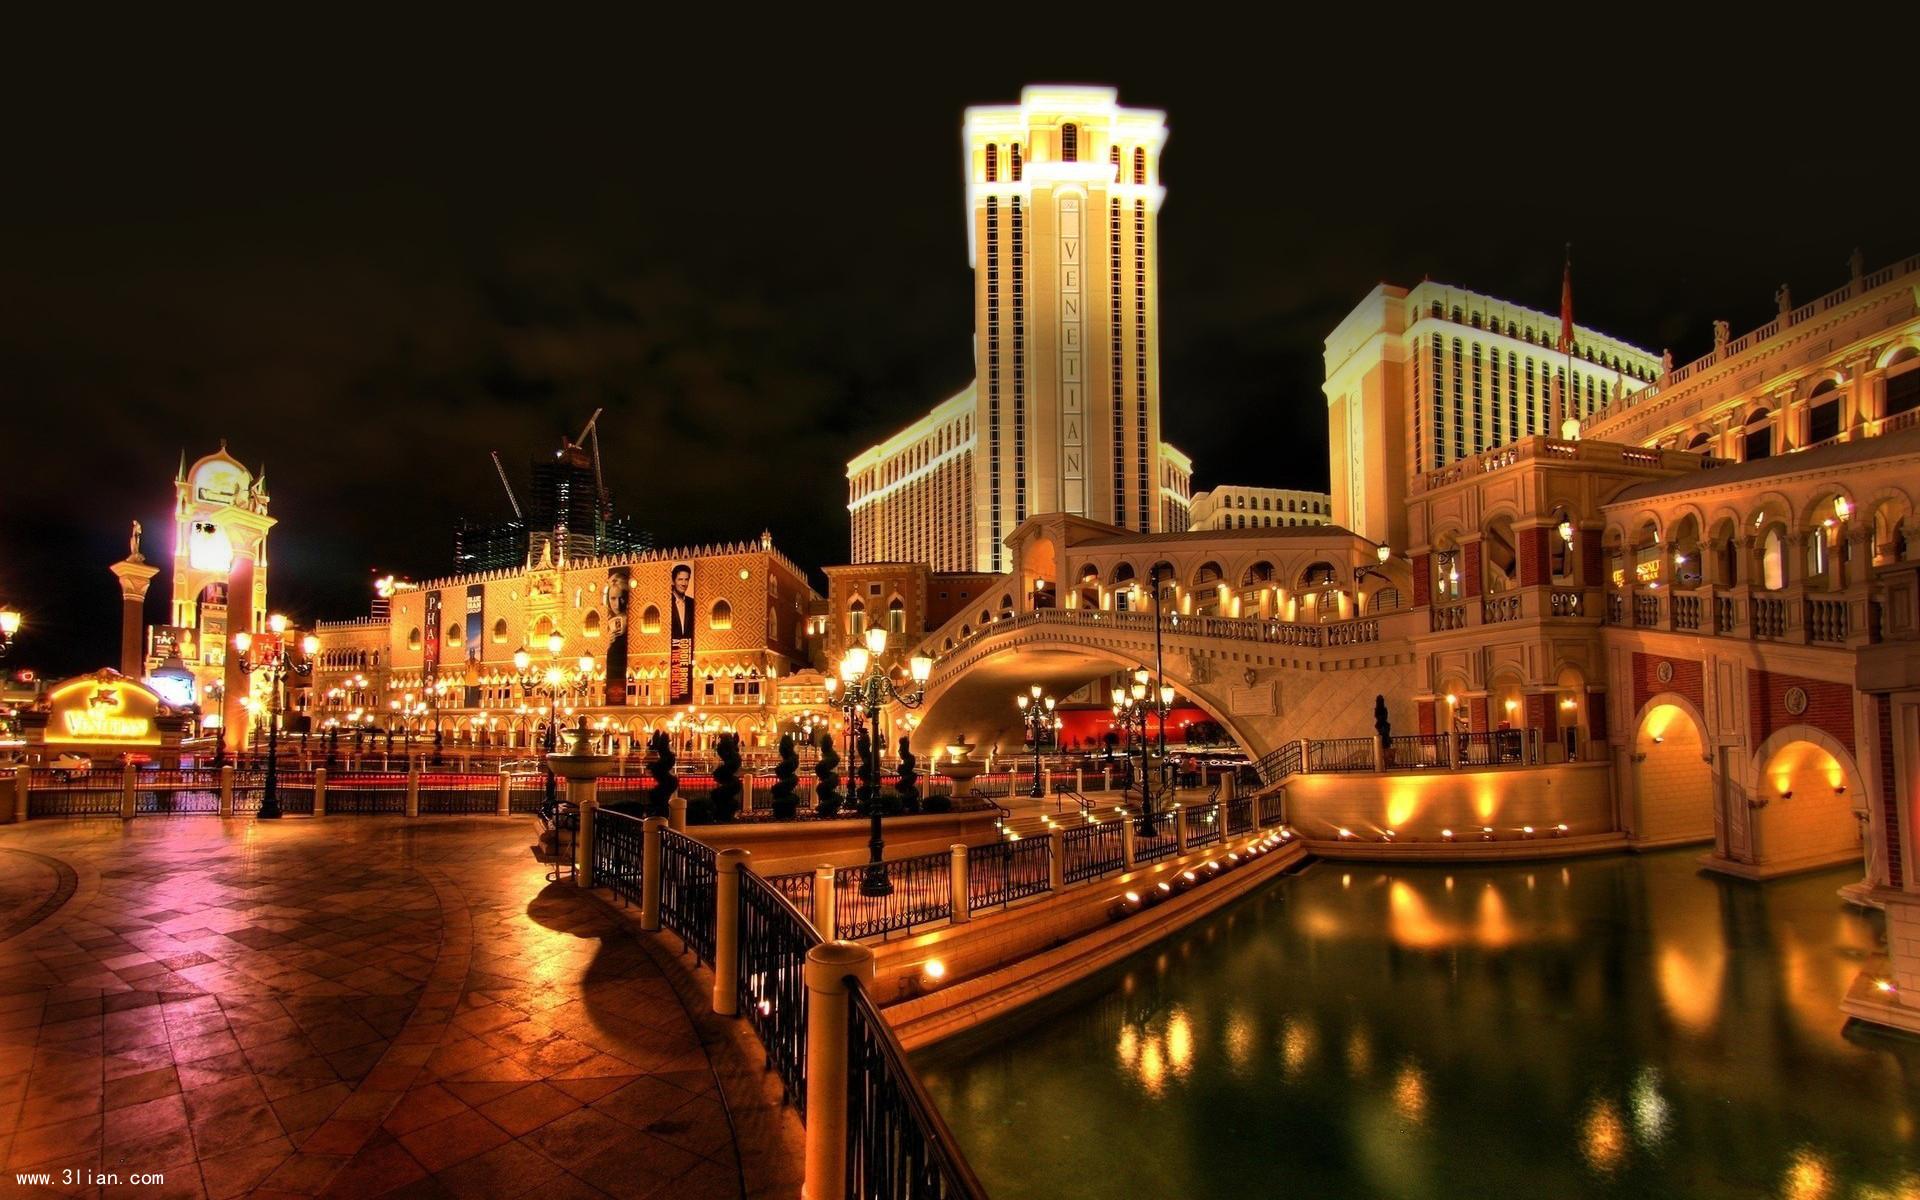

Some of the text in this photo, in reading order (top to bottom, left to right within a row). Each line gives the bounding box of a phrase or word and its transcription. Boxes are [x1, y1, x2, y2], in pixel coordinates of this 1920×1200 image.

[1064, 241, 1080, 473] VENETIAN
[679, 638, 689, 695] GORDIE BROWN
